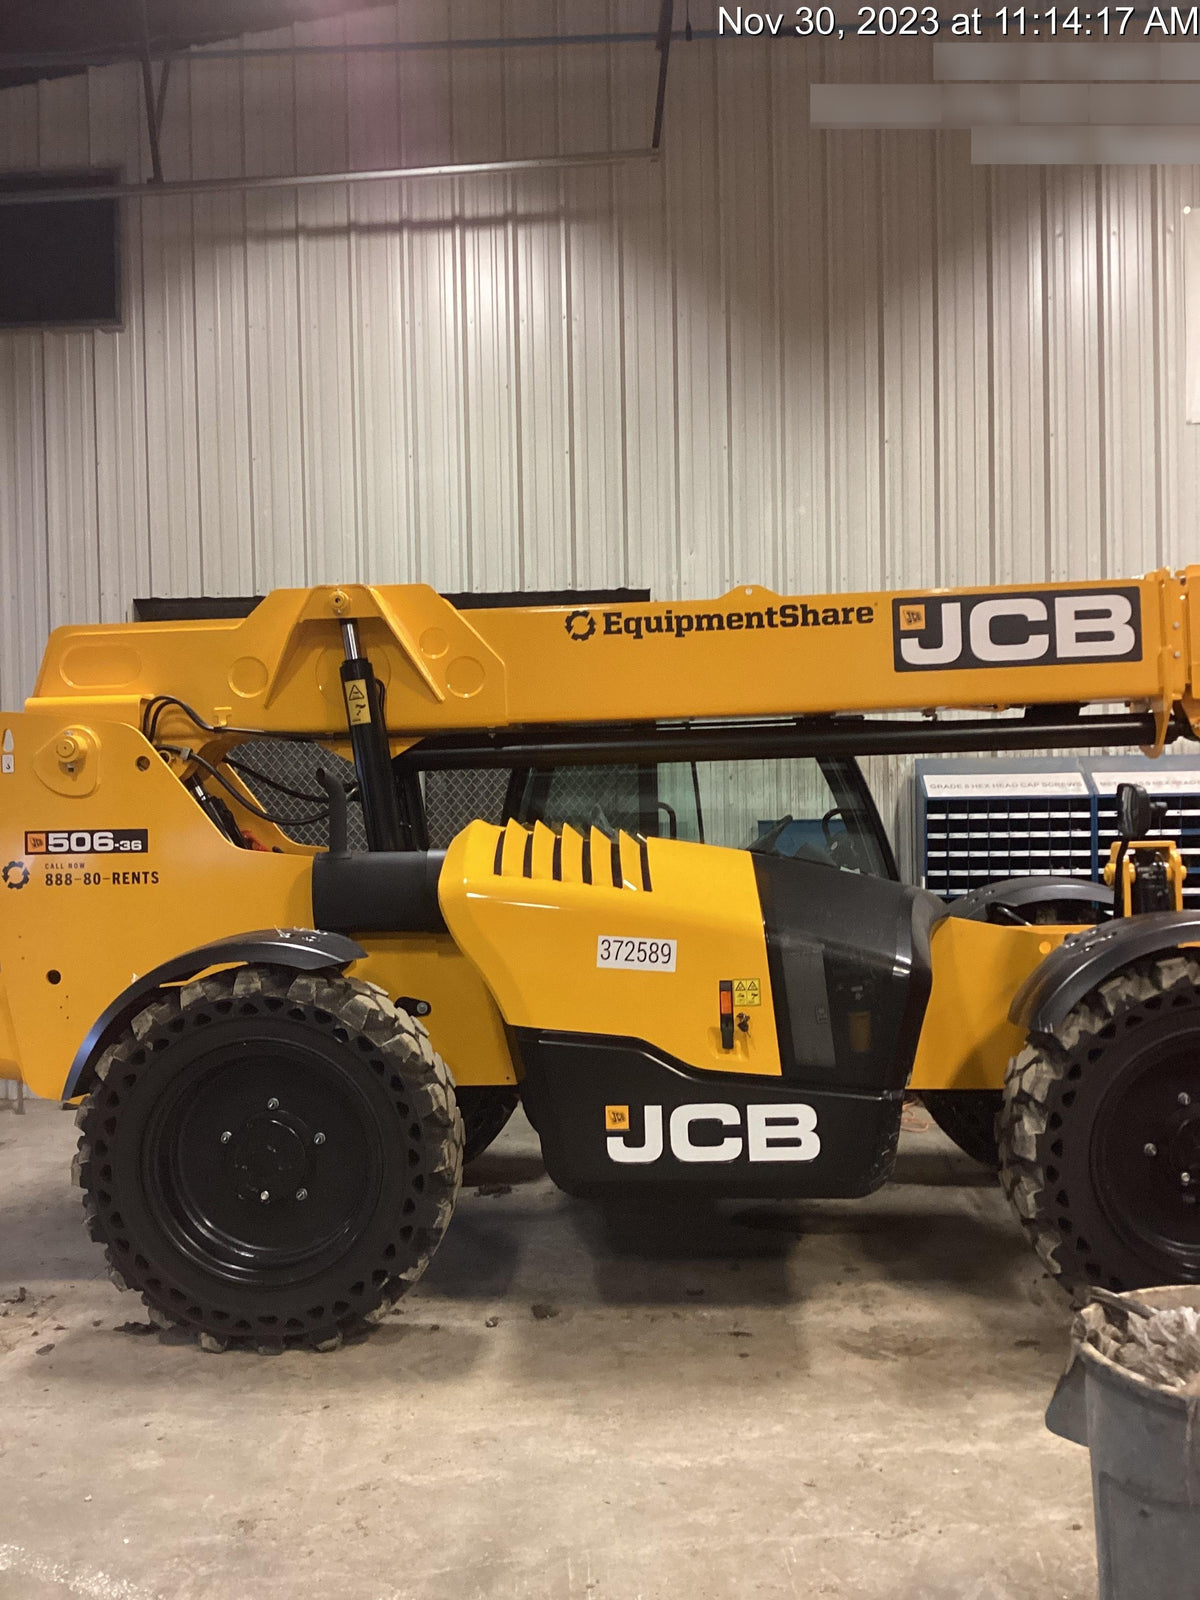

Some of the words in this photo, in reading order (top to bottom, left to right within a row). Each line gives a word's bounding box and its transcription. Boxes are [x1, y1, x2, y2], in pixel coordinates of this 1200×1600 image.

[603, 604, 875, 640] EquipmentShare
[901, 594, 1136, 665] JCB
[45, 871, 159, 886] 888-80-RENTS
[600, 939, 672, 964] 372589
[606, 1103, 821, 1162] JCB
